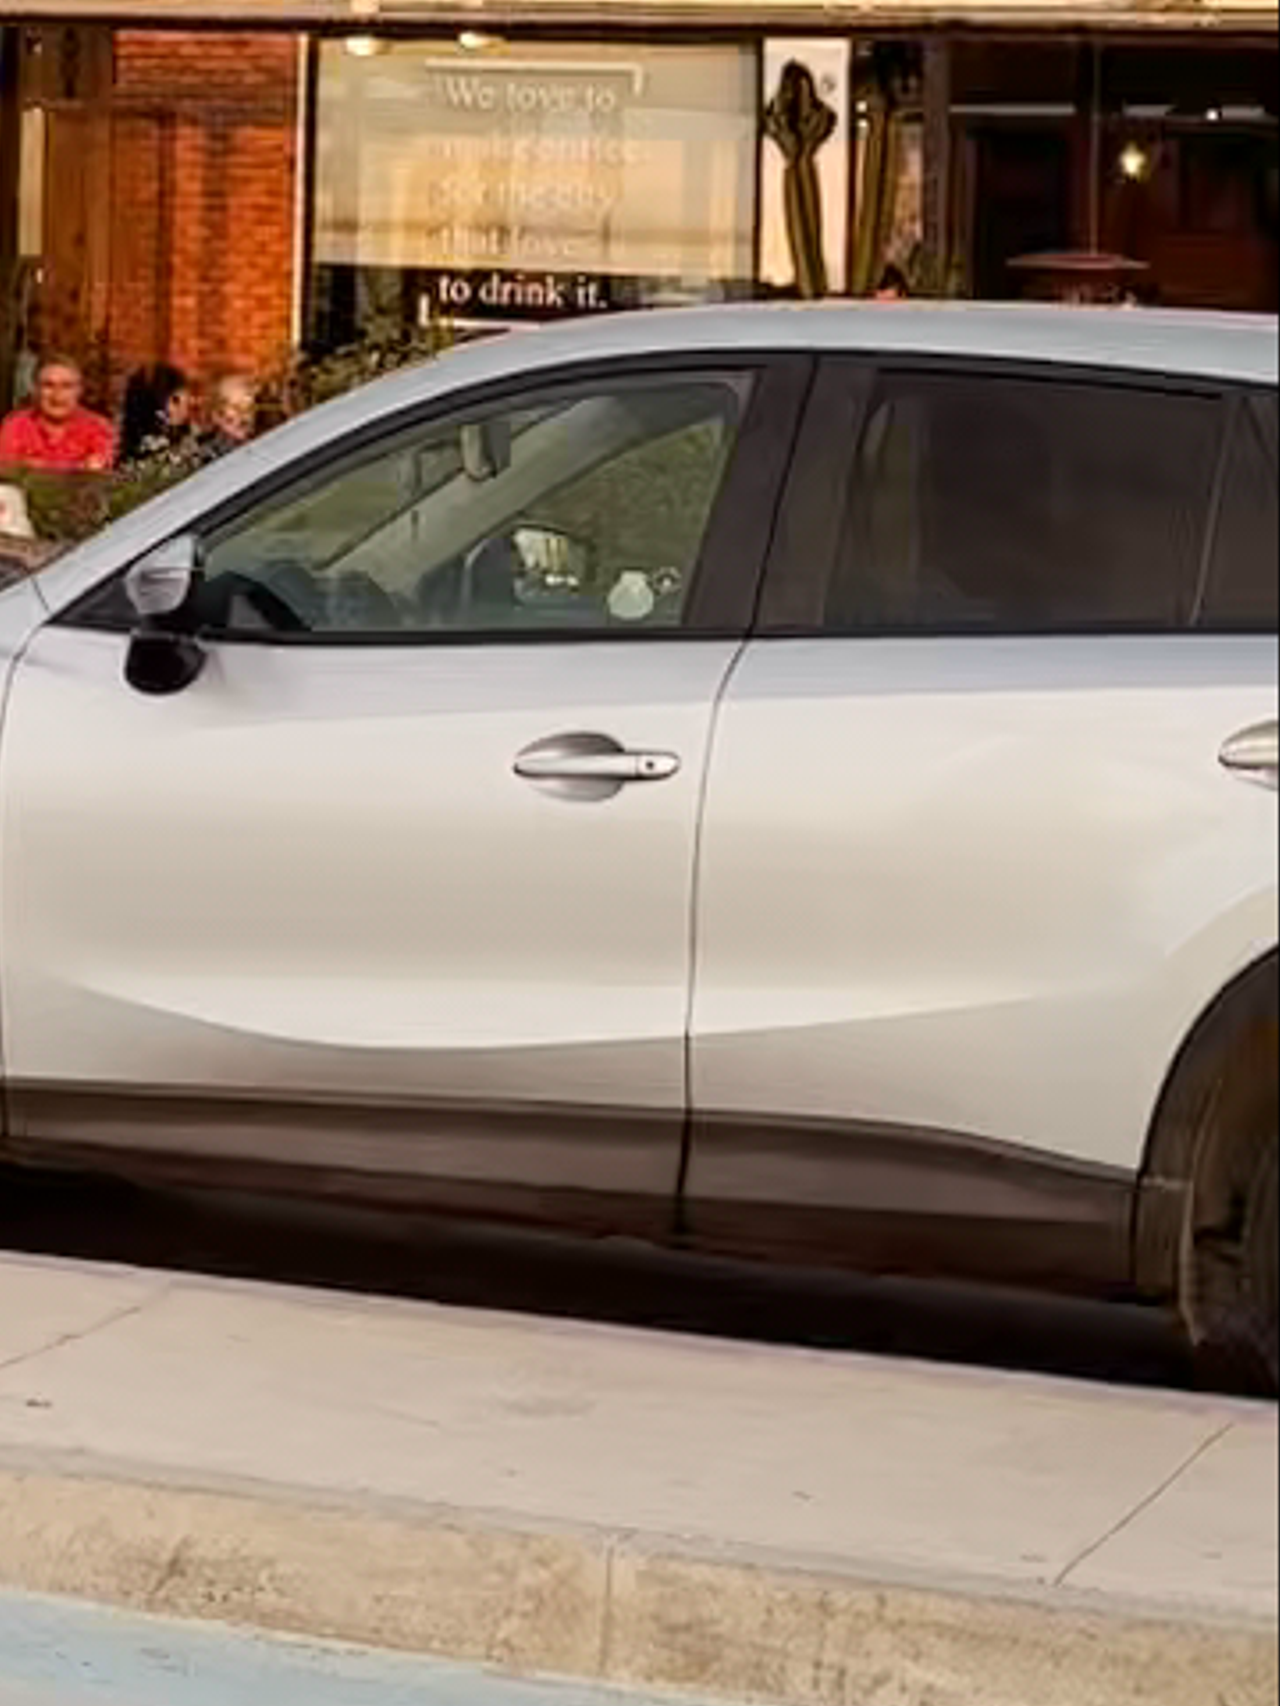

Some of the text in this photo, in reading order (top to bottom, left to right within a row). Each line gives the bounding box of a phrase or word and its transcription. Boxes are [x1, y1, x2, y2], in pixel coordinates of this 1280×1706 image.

[444, 76, 494, 108] We
[586, 85, 617, 113] to
[438, 273, 608, 308] to drink it.
